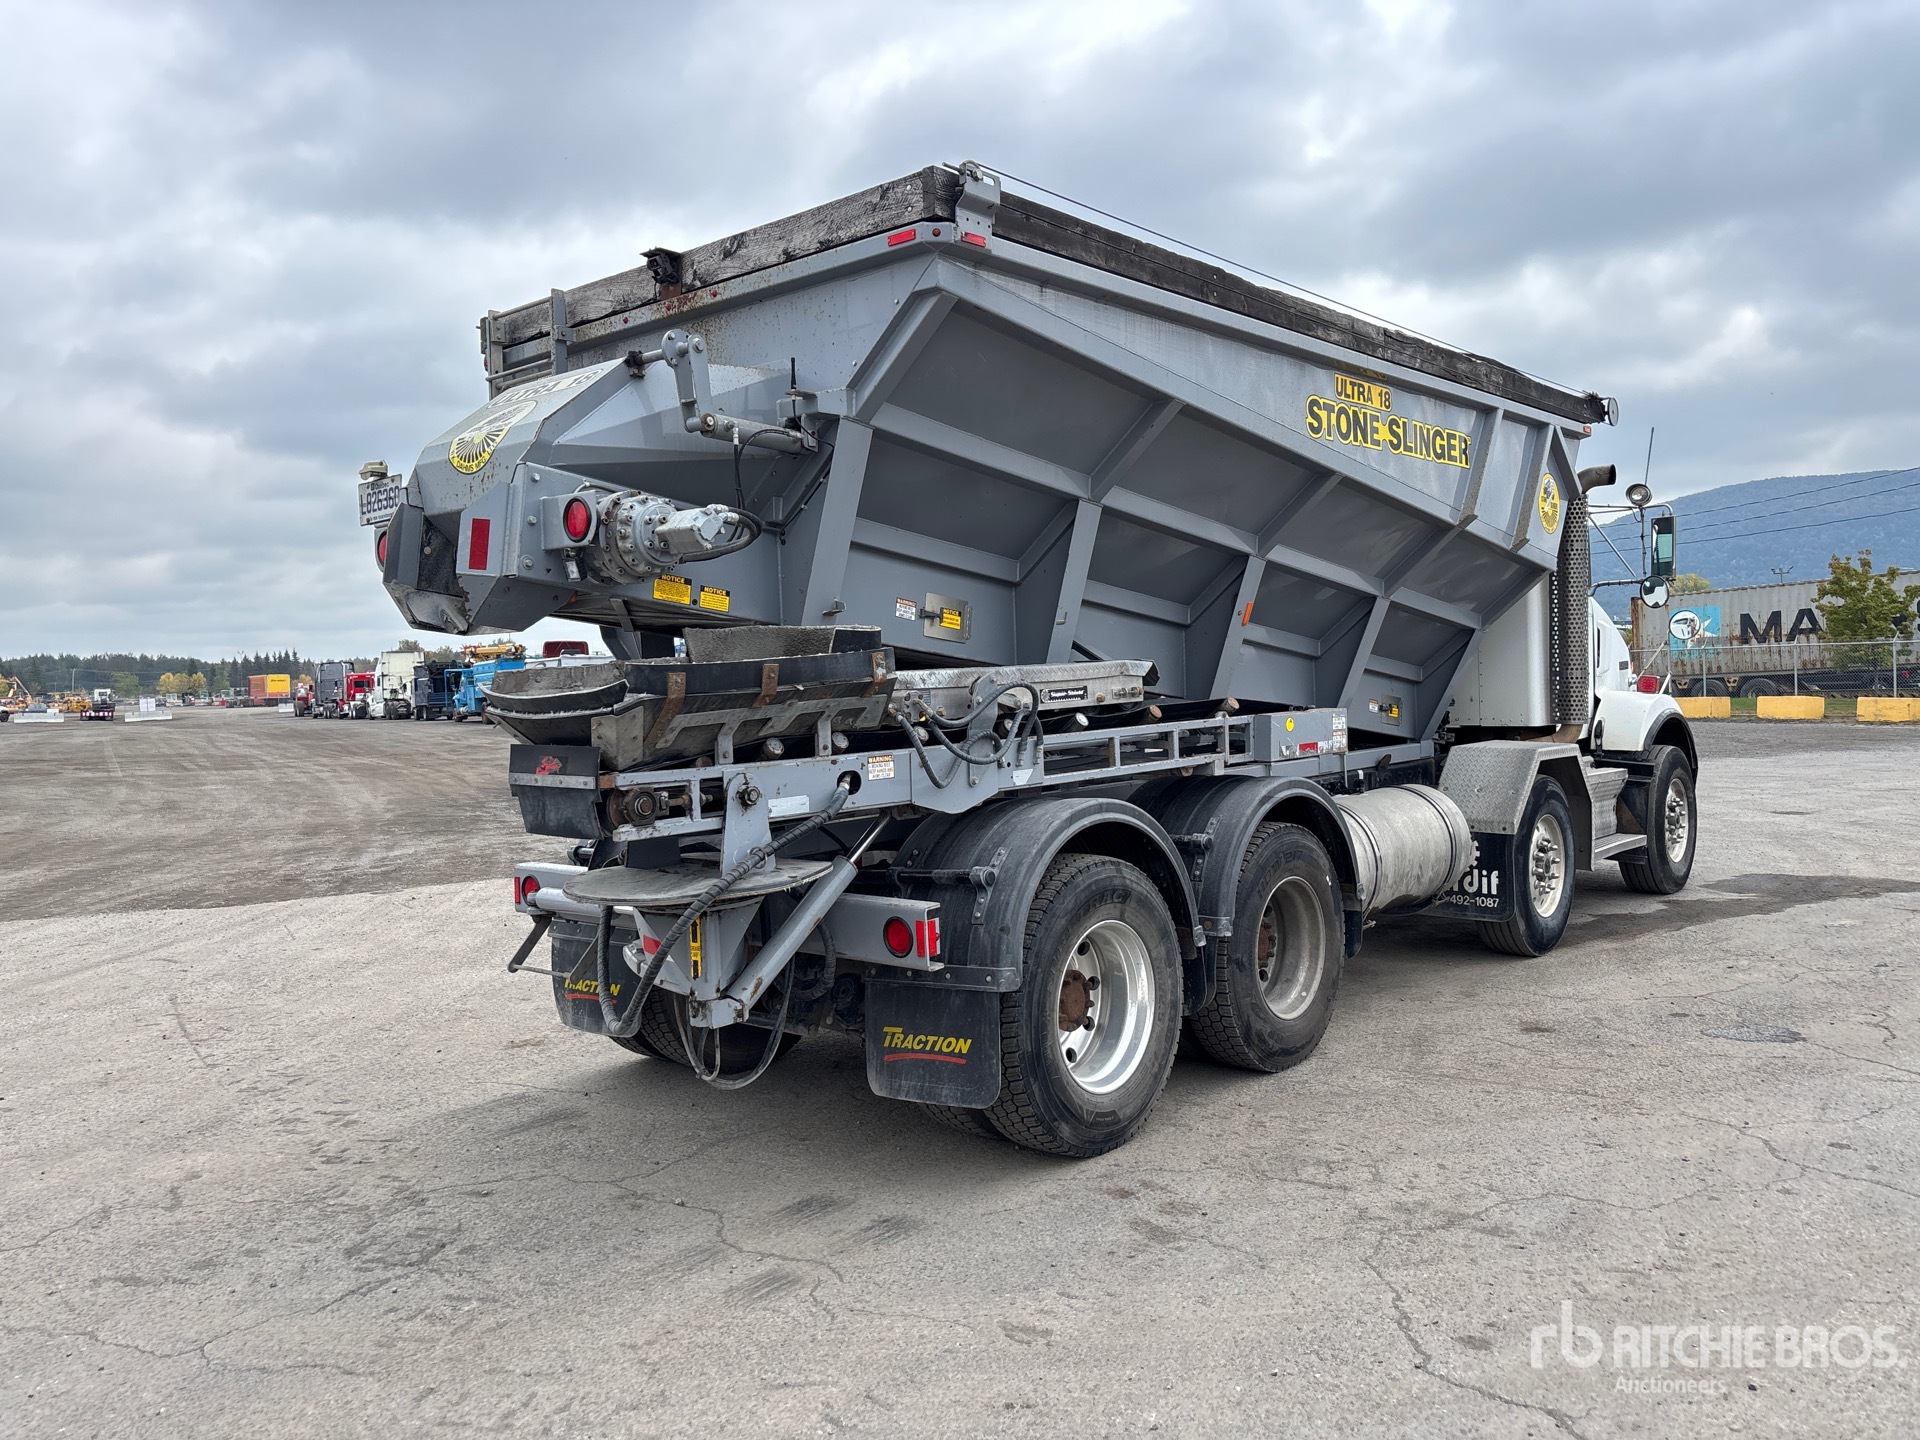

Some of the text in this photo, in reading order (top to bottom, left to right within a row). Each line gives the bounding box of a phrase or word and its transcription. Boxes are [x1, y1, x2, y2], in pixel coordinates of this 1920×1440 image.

[490, 380, 562, 406] ULTRA
[1335, 376, 1391, 410] ULTRA 18
[1308, 397, 1470, 466] STONE SLINGER
[360, 485, 400, 515] L826360
[661, 574, 686, 584] NOTICE
[703, 586, 727, 596] NOTICE
[883, 1026, 972, 1054] TRACTION
